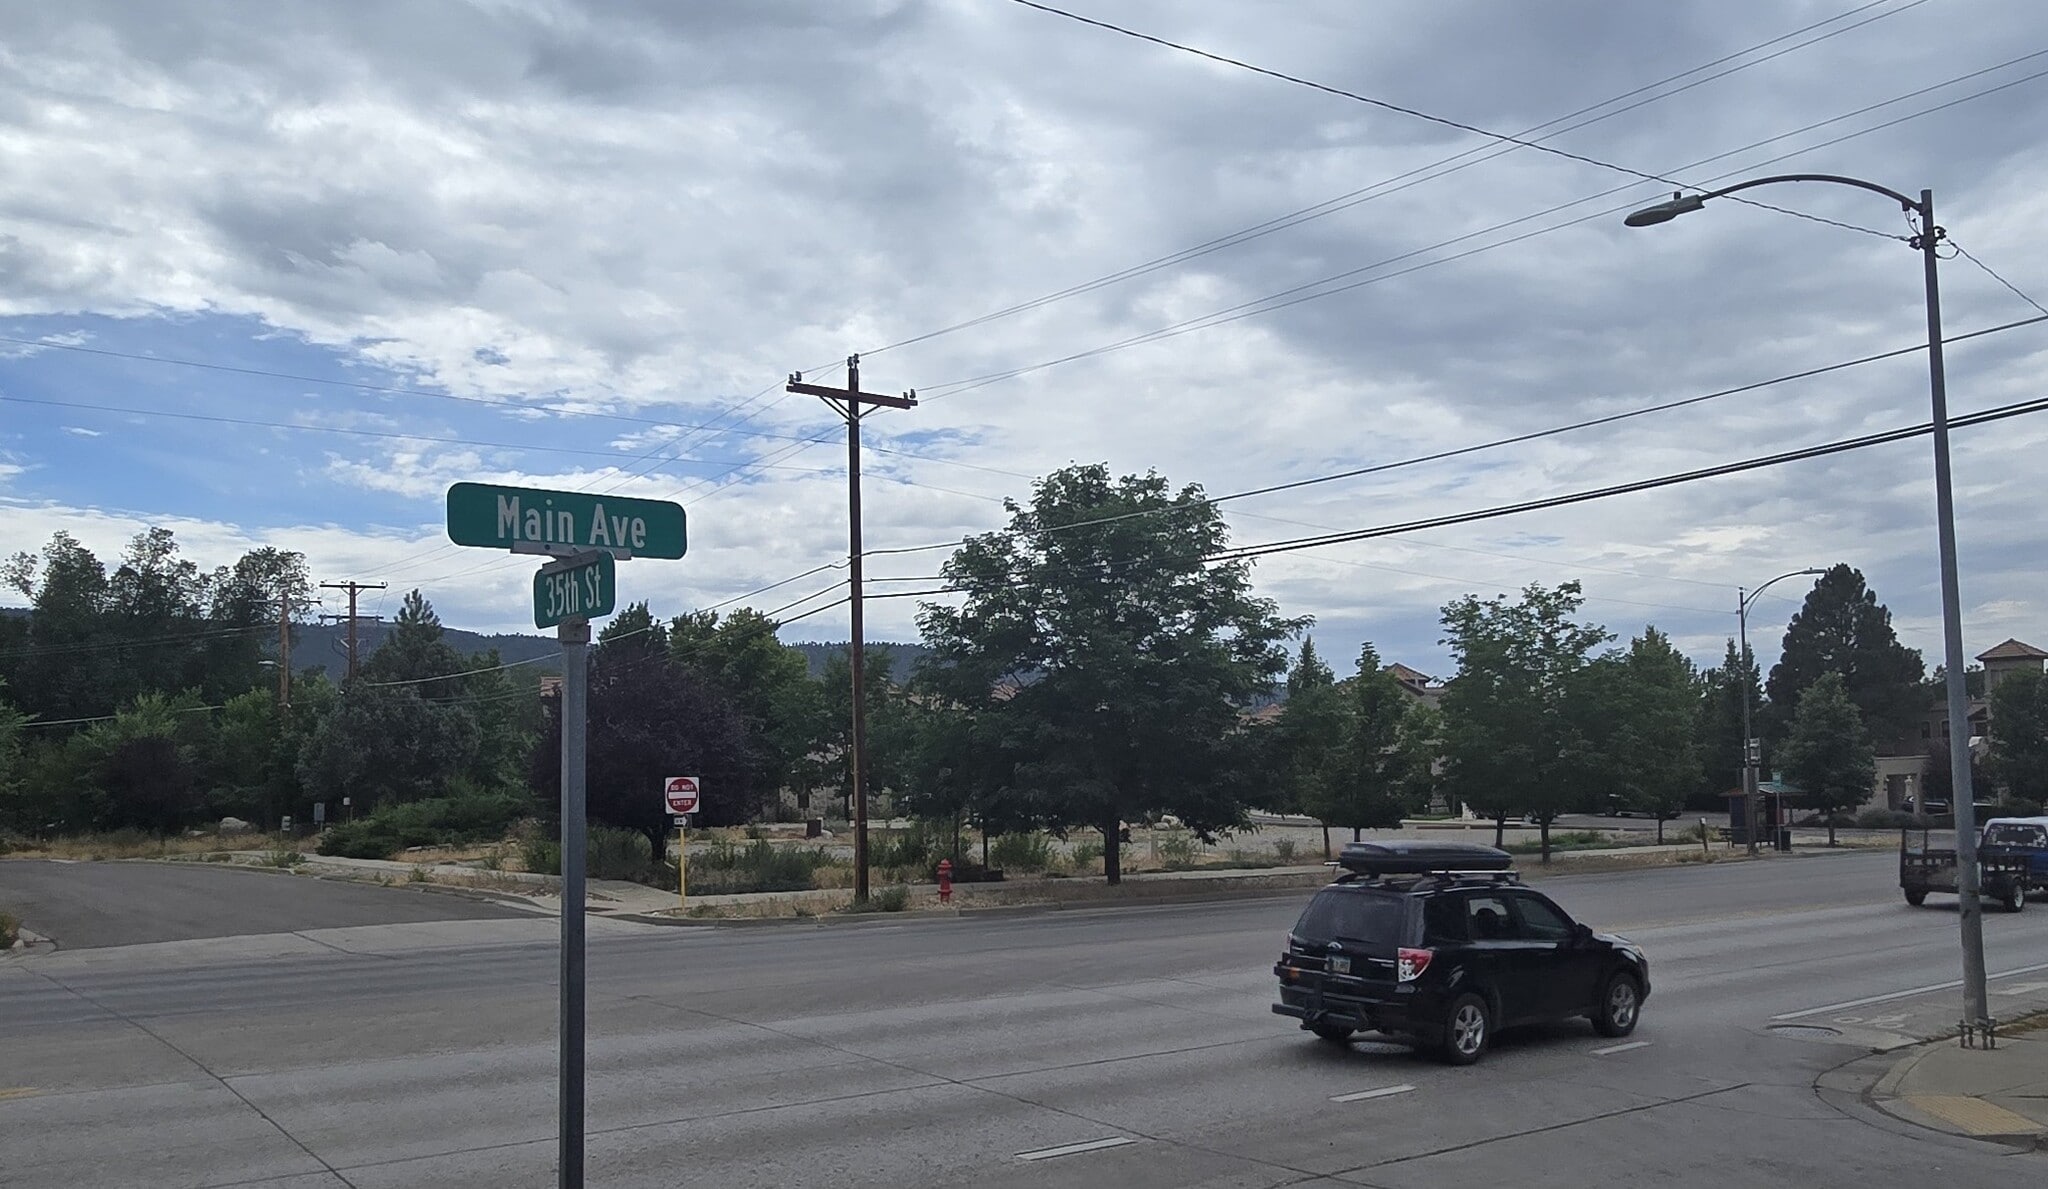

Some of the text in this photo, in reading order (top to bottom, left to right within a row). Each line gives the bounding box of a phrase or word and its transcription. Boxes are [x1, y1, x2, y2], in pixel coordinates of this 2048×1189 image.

[497, 494, 646, 548] Main Ave
[546, 564, 601, 618] 35th St
